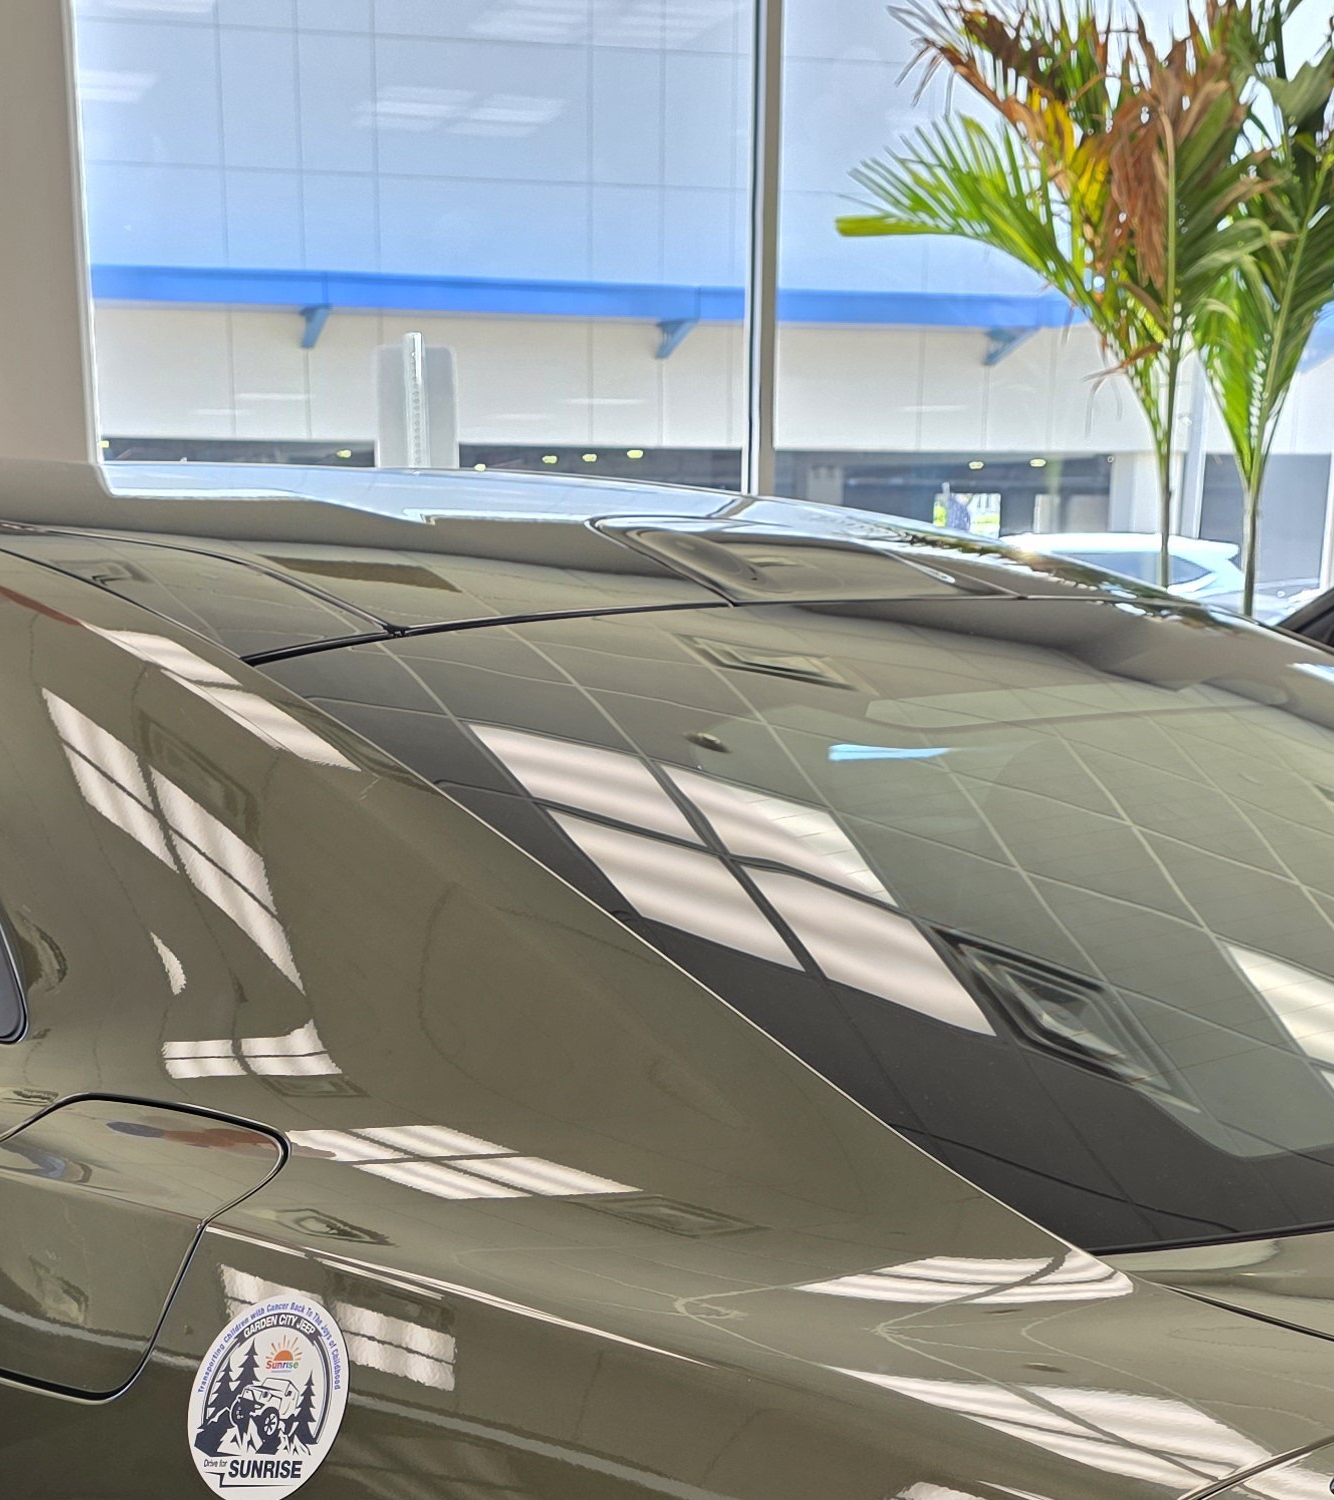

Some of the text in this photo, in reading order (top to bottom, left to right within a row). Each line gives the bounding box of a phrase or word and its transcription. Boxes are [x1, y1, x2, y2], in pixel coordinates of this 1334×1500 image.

[243, 1313, 316, 1337] GARDEN CITY JEEP
[198, 1302, 341, 1393] Transporting Children with Cancer Back To The Joys of Childhood
[265, 1360, 299, 1369] Sunrise
[204, 1458, 303, 1479] Drive for SUNRISE
